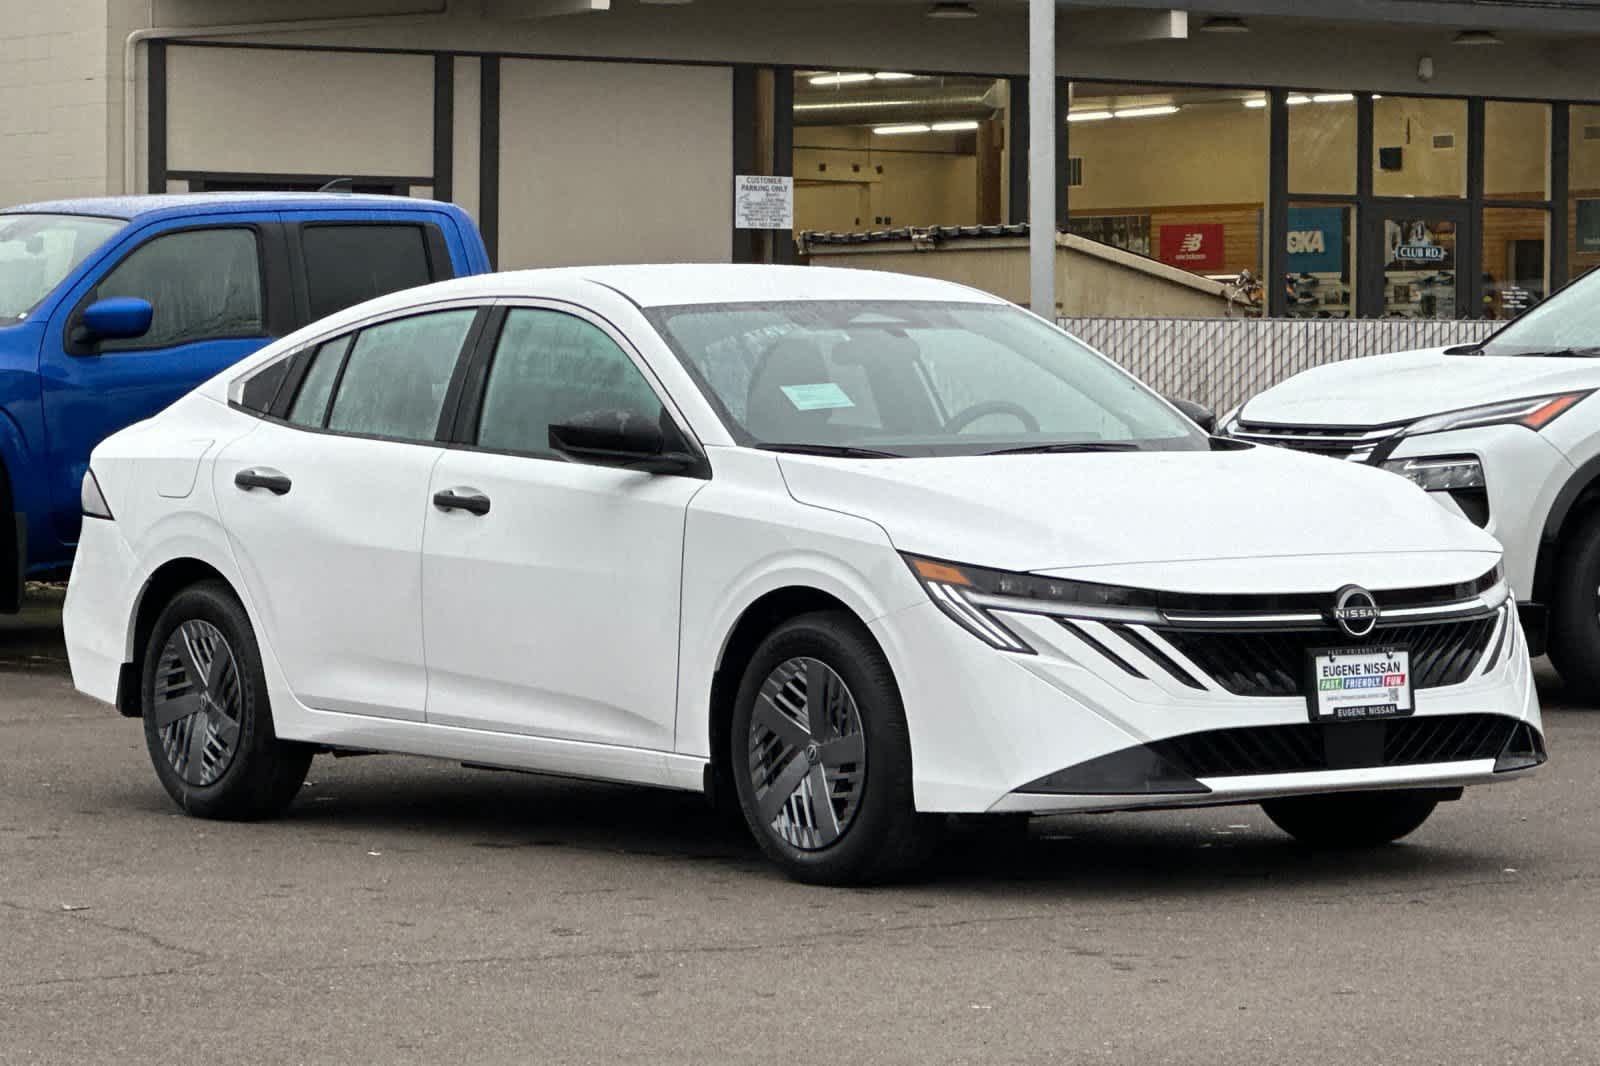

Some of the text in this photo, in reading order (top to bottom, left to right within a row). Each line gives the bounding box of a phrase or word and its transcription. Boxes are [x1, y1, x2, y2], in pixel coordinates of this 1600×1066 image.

[741, 184, 769, 192] PARKING
[1287, 230, 1325, 254] OKA
[1400, 247, 1423, 258] CLUB
[1335, 609, 1380, 618] NISSAN
[1323, 661, 1401, 677] EUGENE NISSAN
[1321, 678, 1341, 689] FAST.
[1386, 675, 1404, 686] FUN.
[1337, 705, 1396, 717] EUGENE NISSAN
